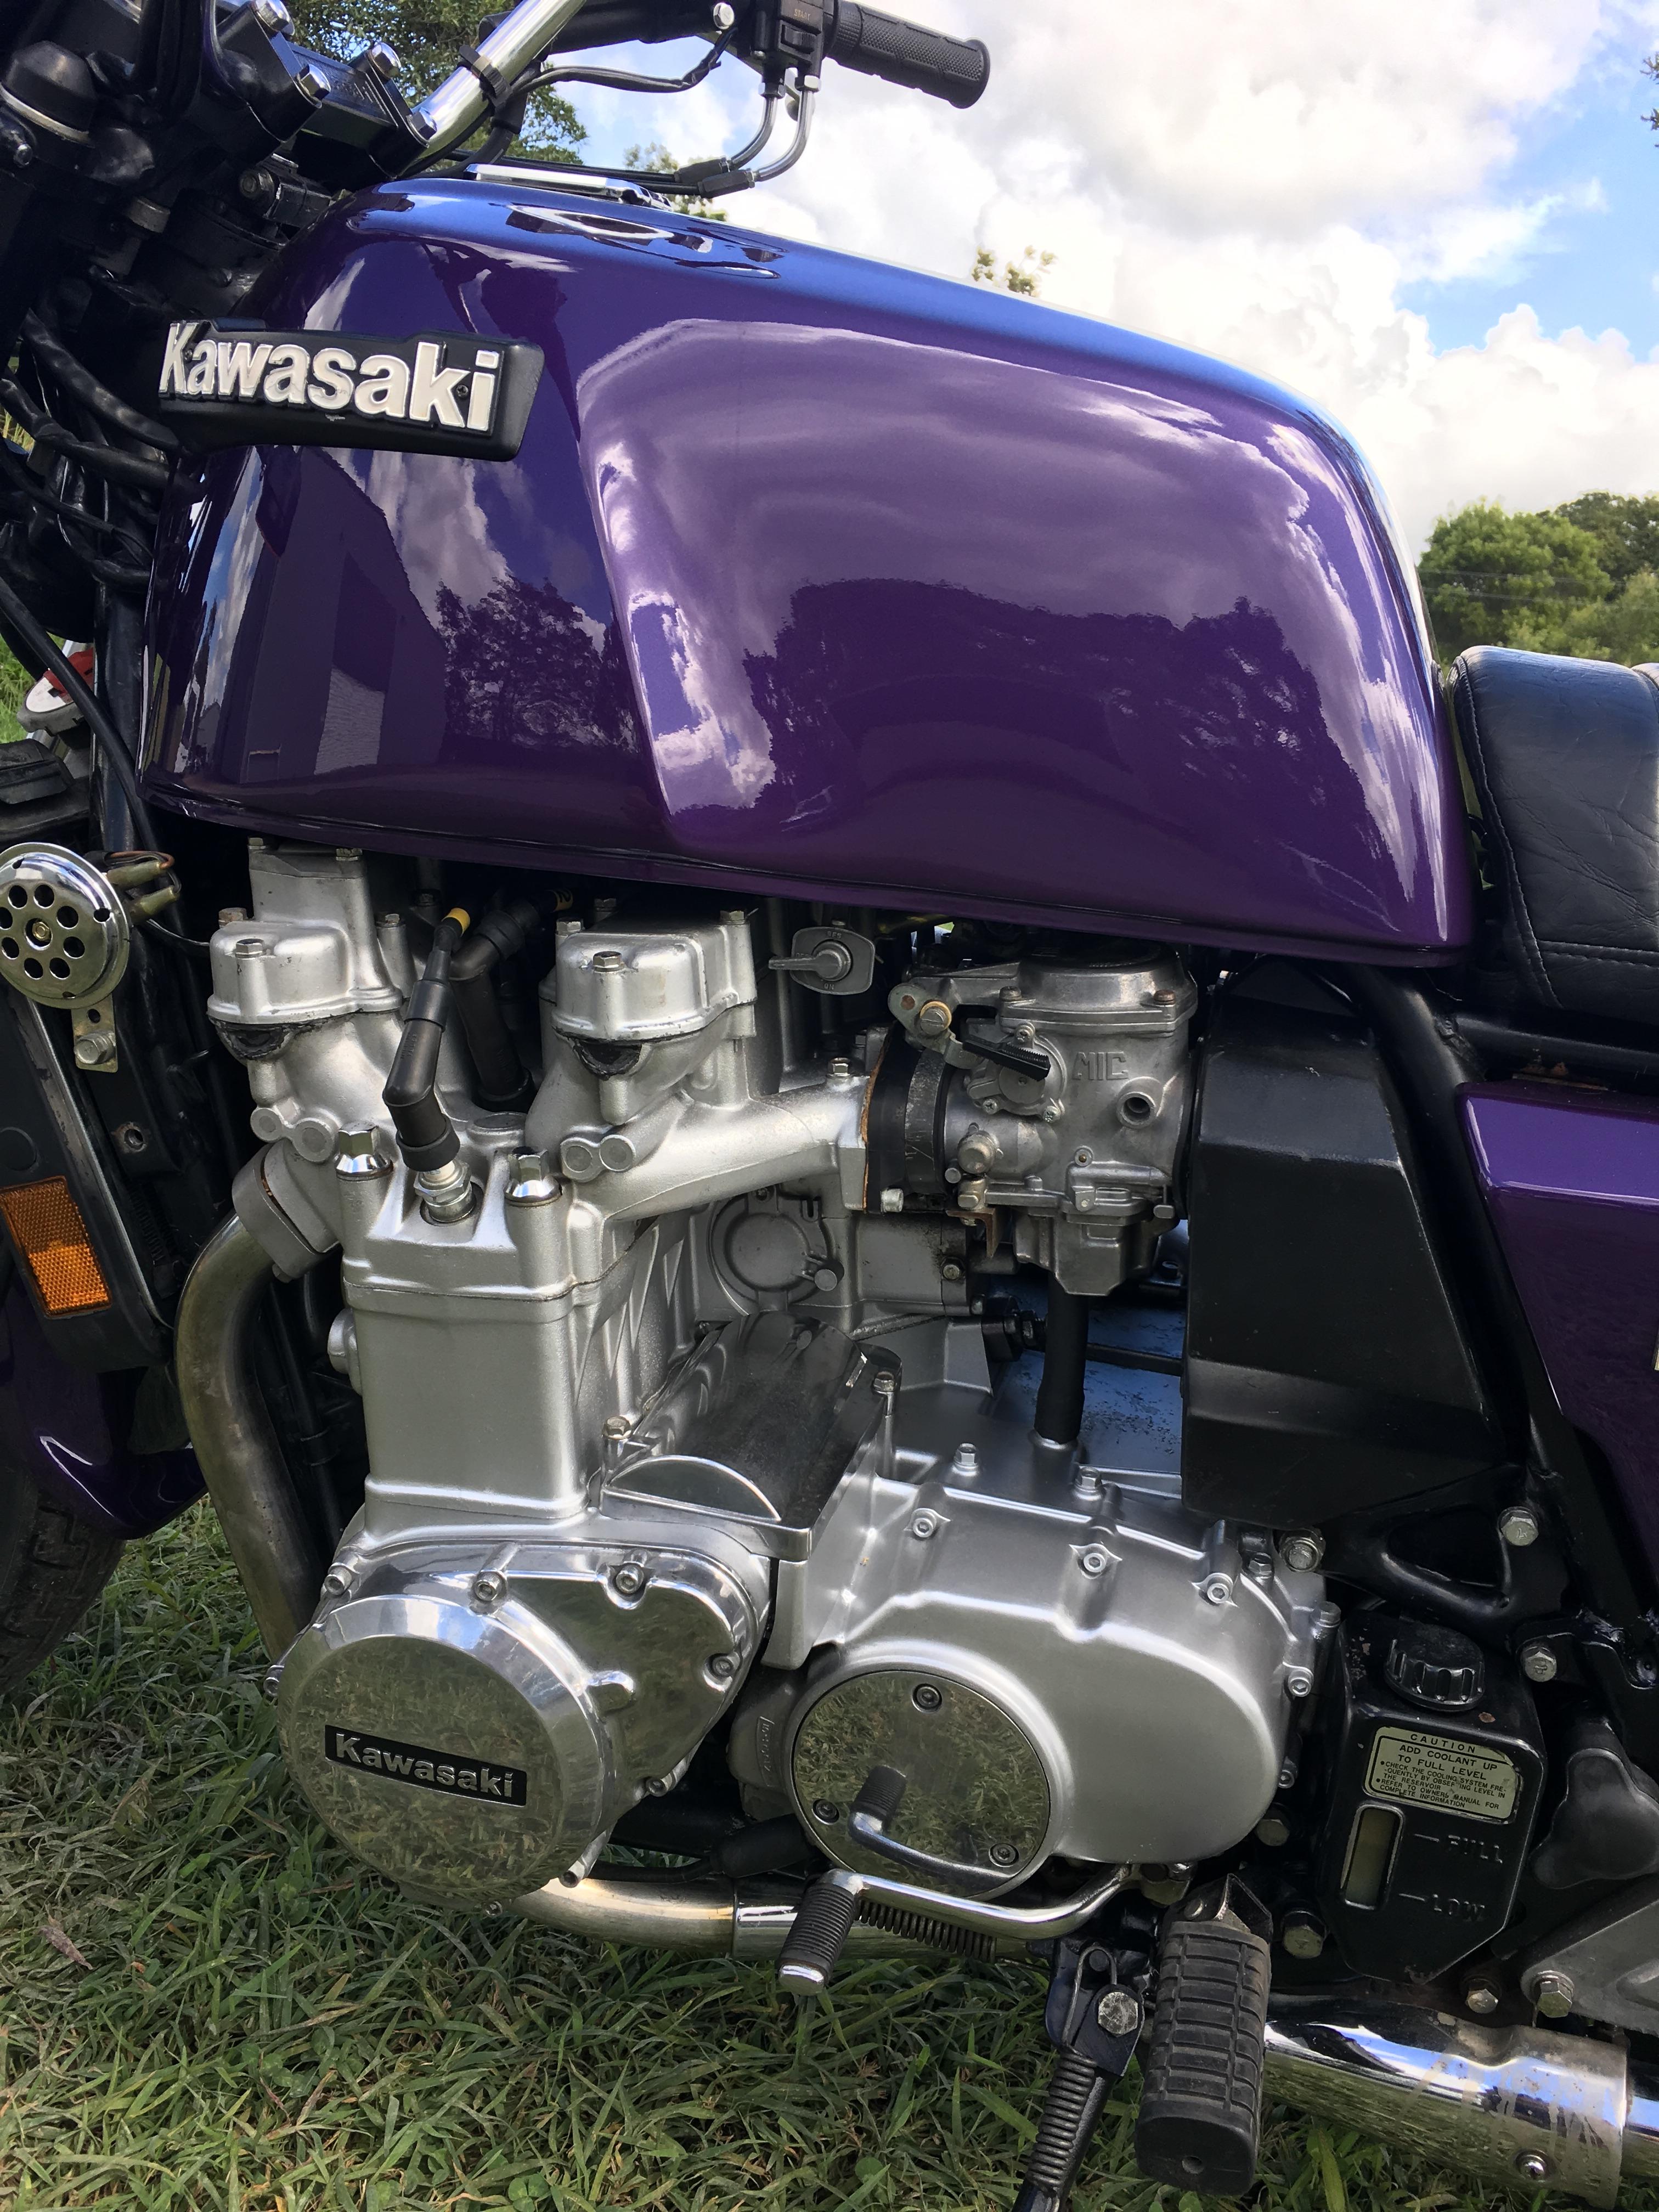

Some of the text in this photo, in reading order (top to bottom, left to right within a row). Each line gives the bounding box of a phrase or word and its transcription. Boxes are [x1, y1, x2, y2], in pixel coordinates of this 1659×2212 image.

[158, 320, 499, 432] Kawasaki
[1410, 1734, 1475, 1753] CAUTION
[335, 1733, 514, 1798] Kawasaki
[1398, 1754, 1486, 1780] TO FULL LEVEL
[1400, 1745, 1498, 1770] ADD COOLANT UP
[1384, 1773, 1441, 1790] THE RESERVOIR
[1386, 1761, 1408, 1771] CHECK
[1427, 1770, 1457, 1781] COOLING
[1460, 1778, 1488, 1788] SYSTEM
[1380, 1784, 1465, 1808] COMPLETE INFORMATION
[1381, 1779, 1403, 1788] REFER
[1453, 1794, 1480, 1806] MANUAL
[1474, 1787, 1494, 1796] LEVEL
